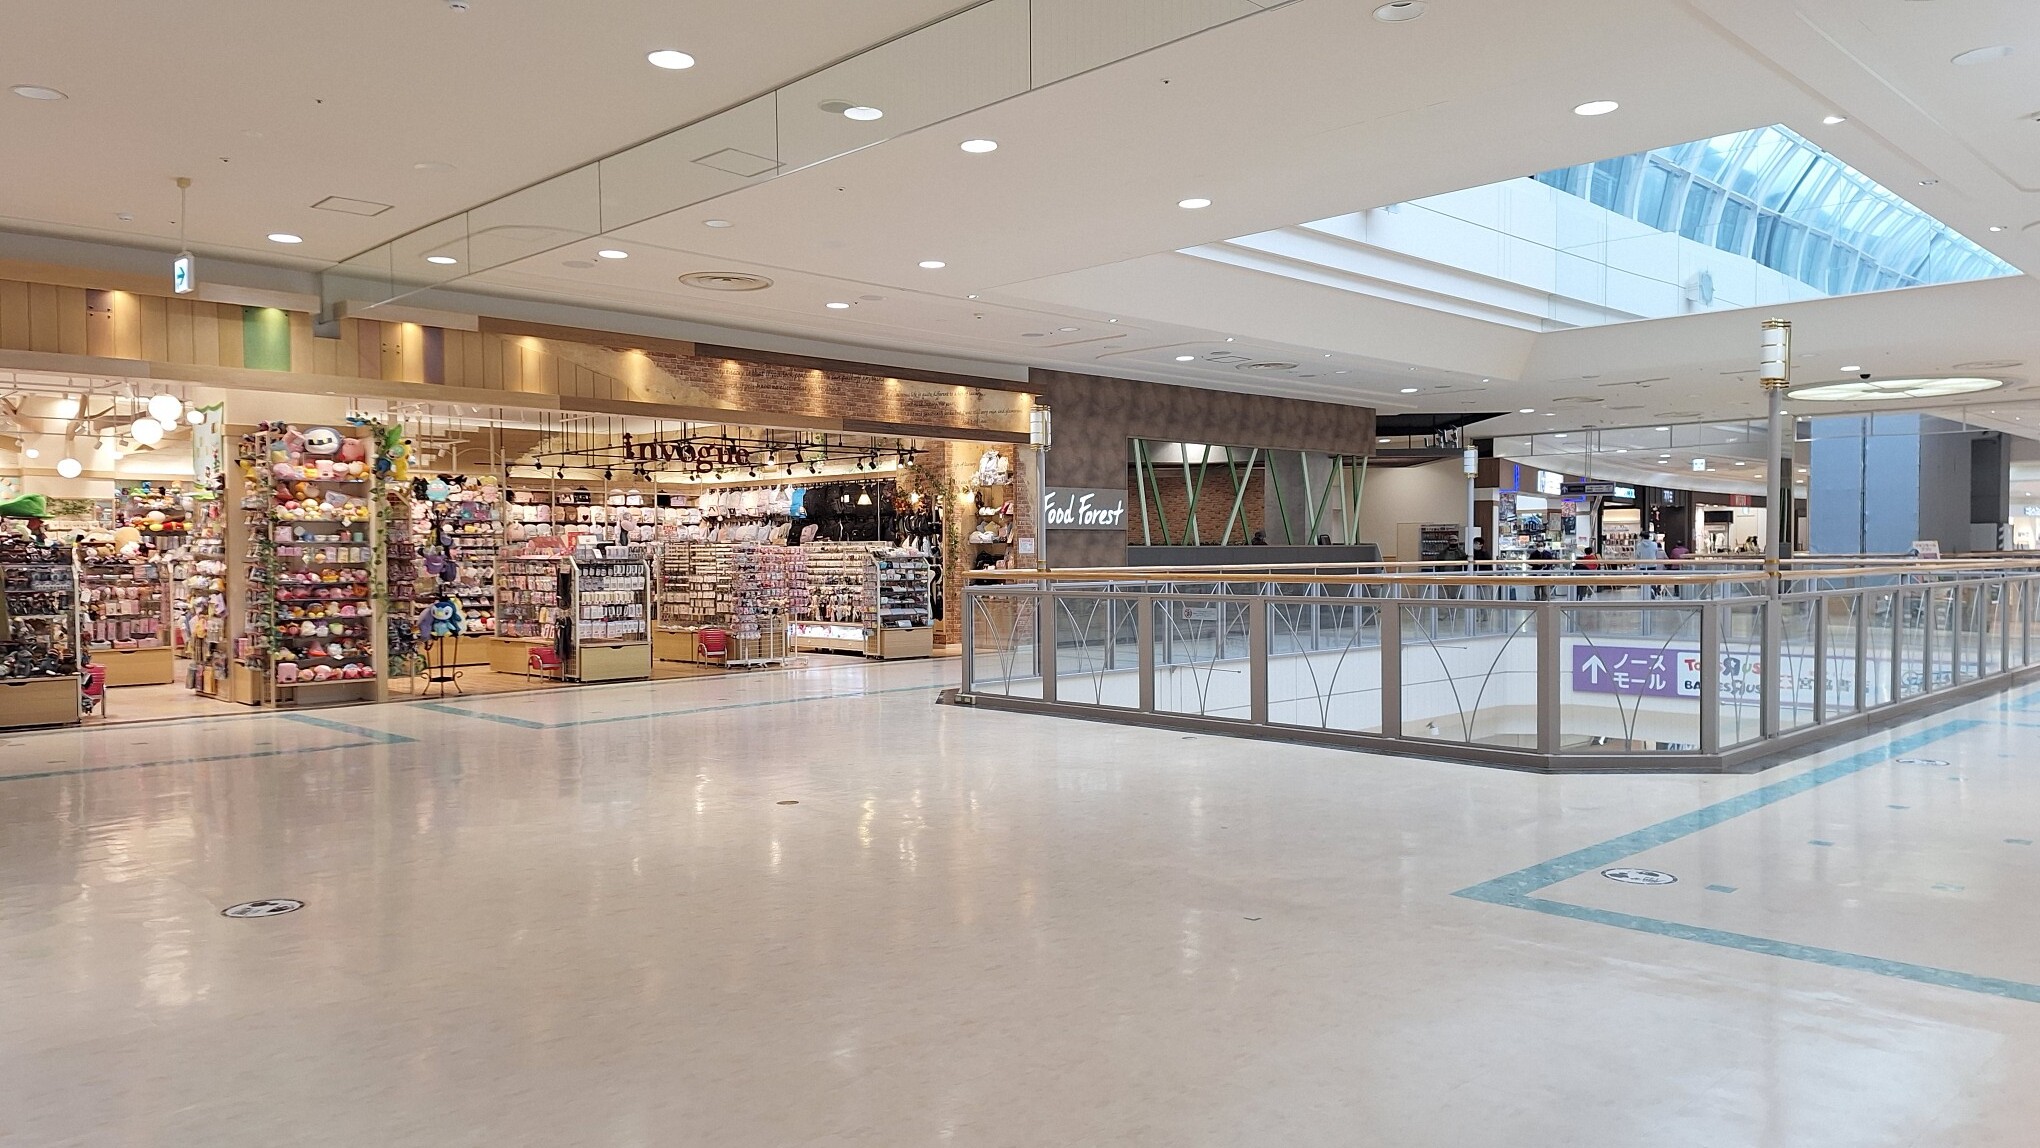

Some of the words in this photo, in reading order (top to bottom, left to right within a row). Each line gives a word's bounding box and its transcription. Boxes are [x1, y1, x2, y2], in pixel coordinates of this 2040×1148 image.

[1044, 492, 1075, 524] Food
[1078, 493, 1124, 525] Forest
[1613, 653, 1666, 682] ノース
[1613, 673, 1666, 690] モール
